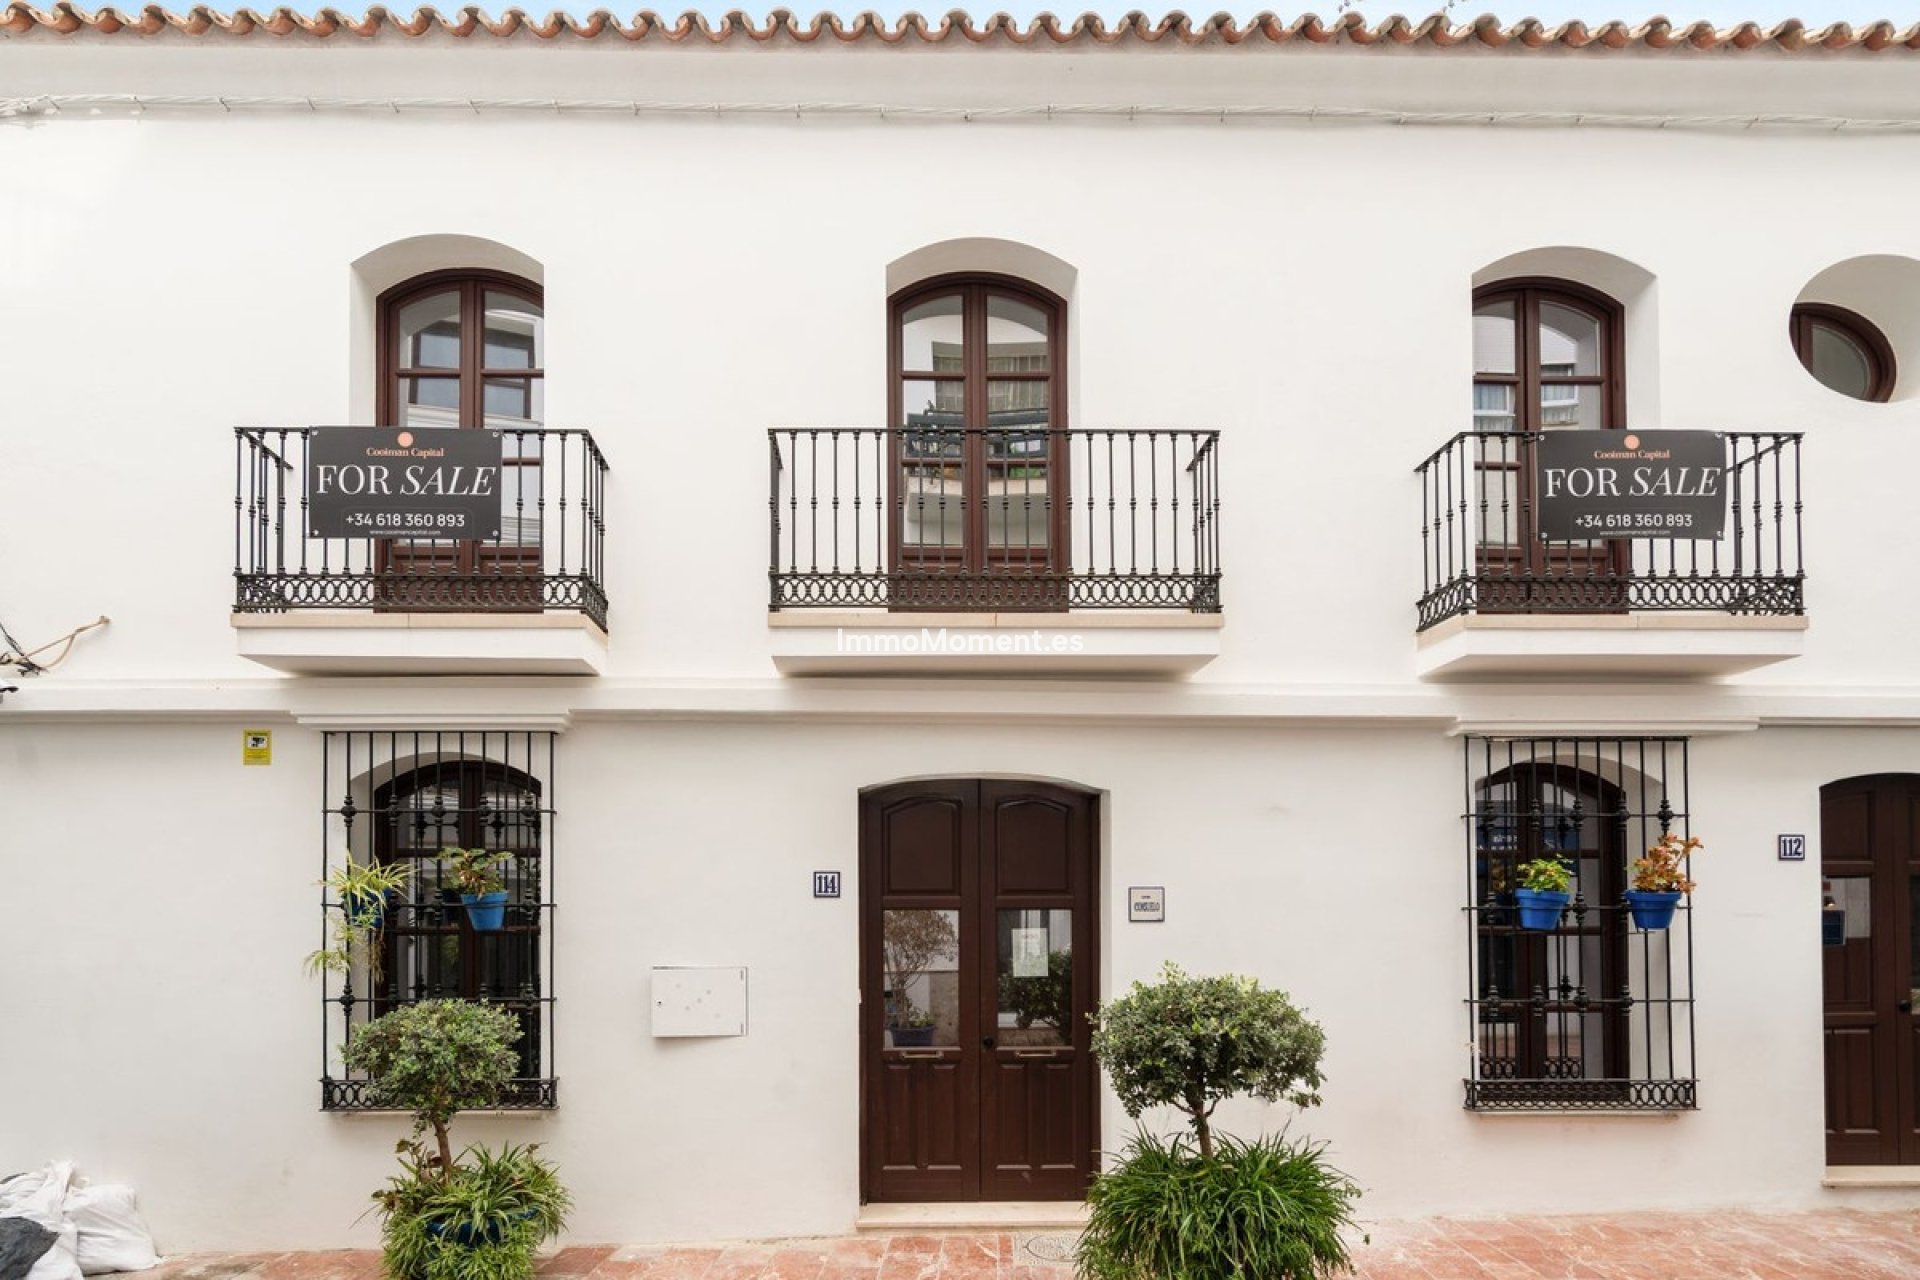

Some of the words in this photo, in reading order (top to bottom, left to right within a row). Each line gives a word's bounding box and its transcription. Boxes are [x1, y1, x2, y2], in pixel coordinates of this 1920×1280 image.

[411, 447, 444, 459] Capital
[1638, 450, 1671, 461] Capital
[316, 464, 392, 495] FOR
[400, 464, 496, 496] SALE
[1544, 467, 1621, 498] FOR
[1628, 466, 1721, 497] SALE
[345, 513, 373, 527] +34
[375, 513, 401, 527] 618
[404, 513, 433, 527] 360
[436, 514, 465, 527] 893
[1575, 514, 1602, 528] +34
[1606, 513, 1632, 527] 618
[1634, 513, 1663, 527] 360
[1666, 513, 1693, 527] 893
[1782, 838, 1802, 856] 112
[817, 875, 837, 893] 114
